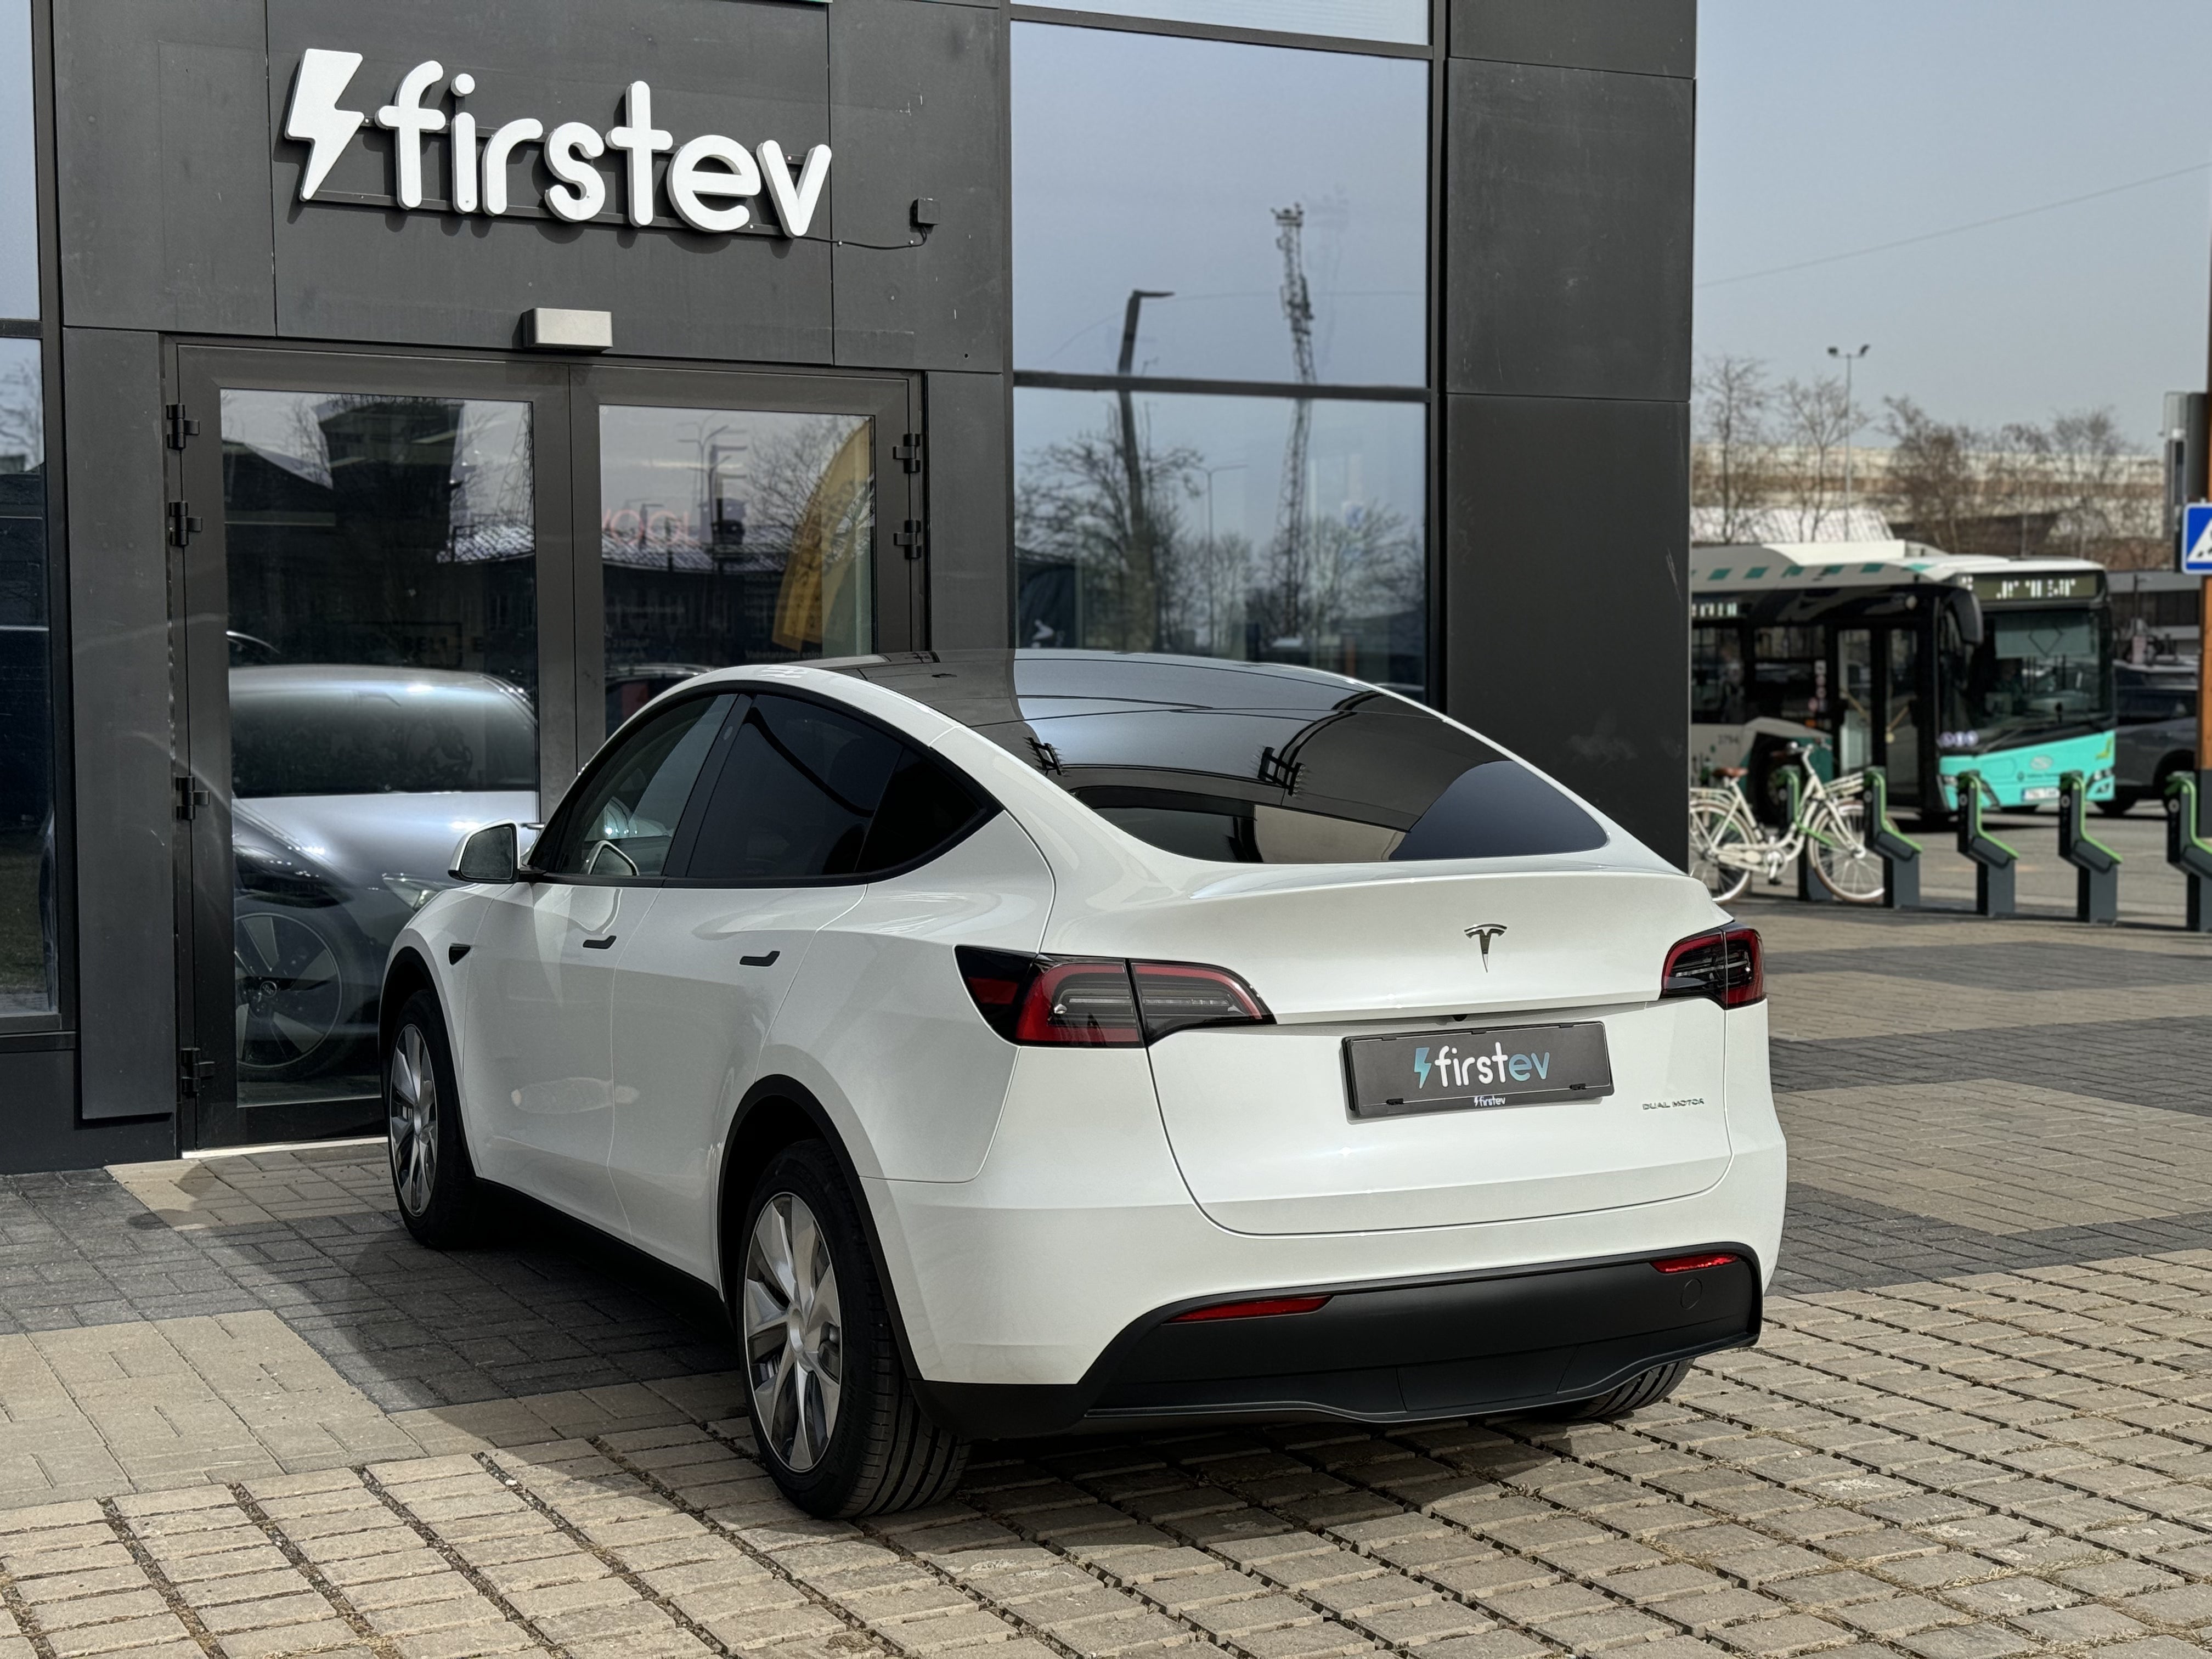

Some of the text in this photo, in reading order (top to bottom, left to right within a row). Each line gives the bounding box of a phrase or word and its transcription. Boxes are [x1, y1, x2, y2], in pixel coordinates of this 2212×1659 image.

[376, 60, 832, 238] firstev
[1435, 1042, 1549, 1087] firstev
[1479, 1095, 1505, 1107] firstev
[1672, 1098, 1705, 1107] MOTOR
